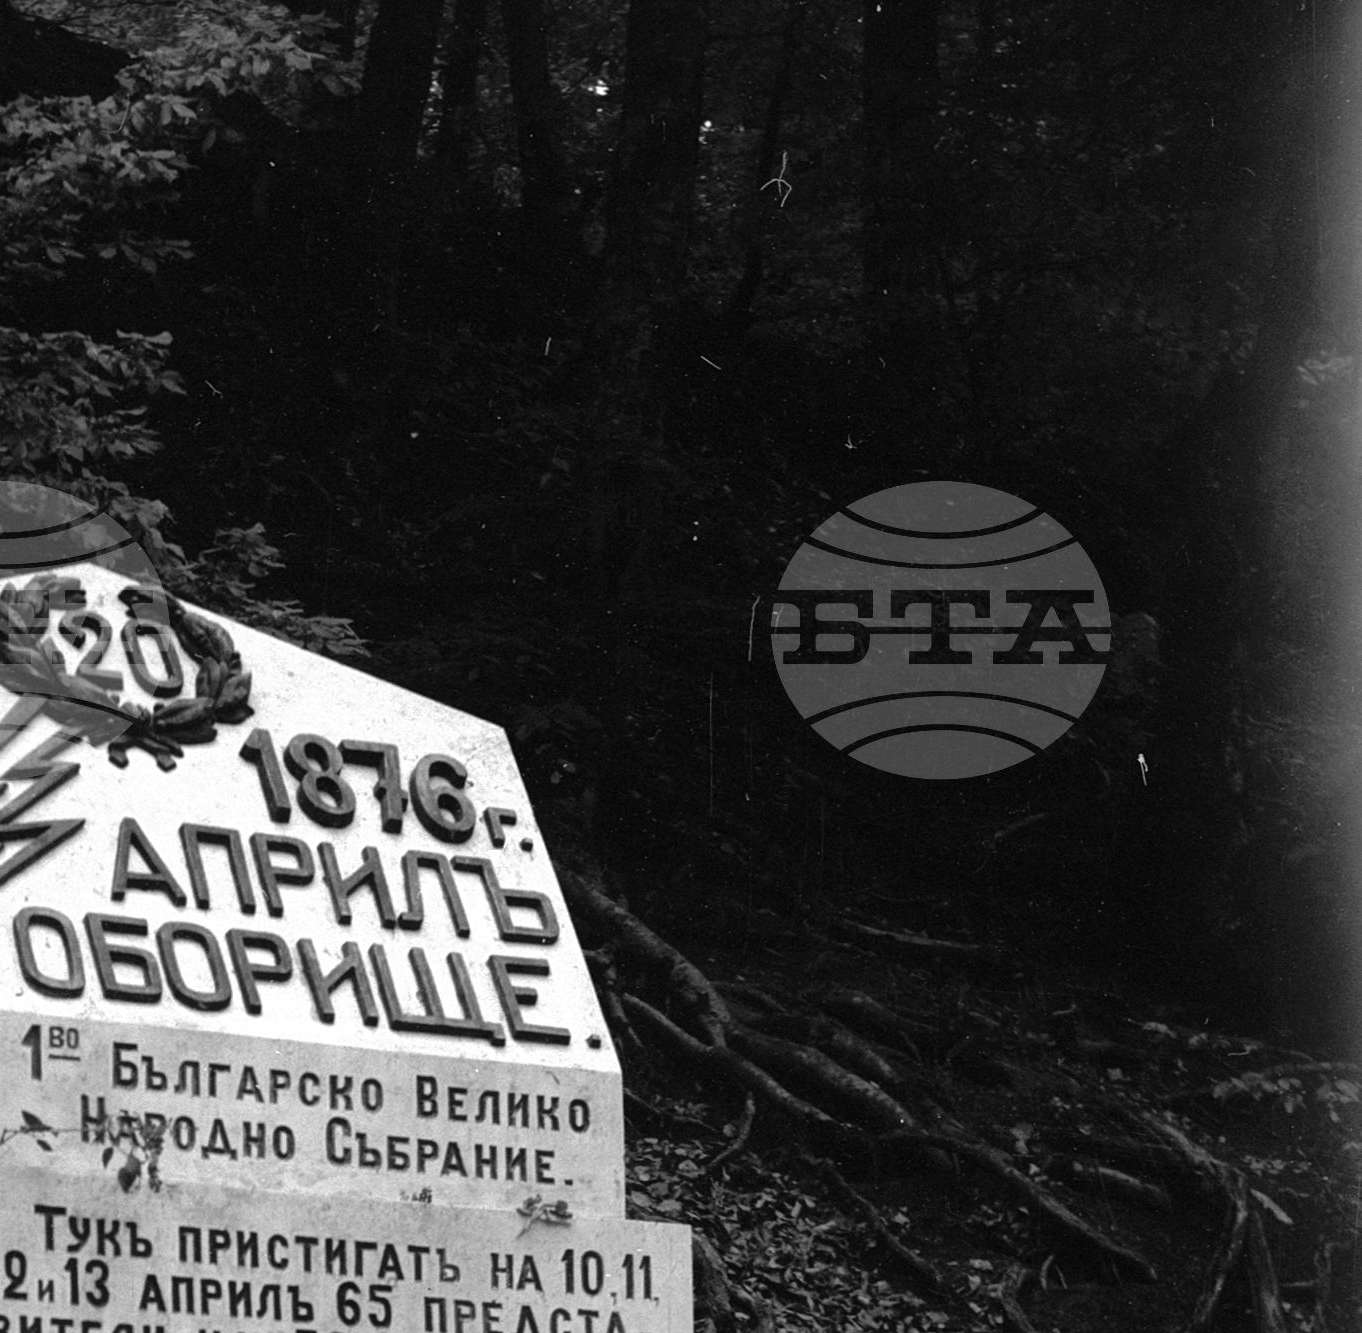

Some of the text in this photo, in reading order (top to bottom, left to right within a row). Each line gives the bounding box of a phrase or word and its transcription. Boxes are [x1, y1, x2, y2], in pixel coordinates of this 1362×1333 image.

[58, 611, 185, 696] 20
[112, 818, 559, 944] АПРИЛЪ
[13, 906, 603, 1049] ОБОРИЩЕ.
[112, 1041, 384, 1111] БЪЛГАРСКО
[416, 1074, 591, 1134] ВЕЛИКО
[325, 1117, 574, 1186] СЪБРАНИЕ.
[35, 1204, 152, 1259] ТУКЪ
[179, 1226, 460, 1283] ПРИСТИГАТЪ
[491, 1252, 543, 1292] НА
[65, 1258, 110, 1307] 13
[140, 1274, 314, 1323] АПРИЛЪ
[337, 1282, 393, 1327] 65
